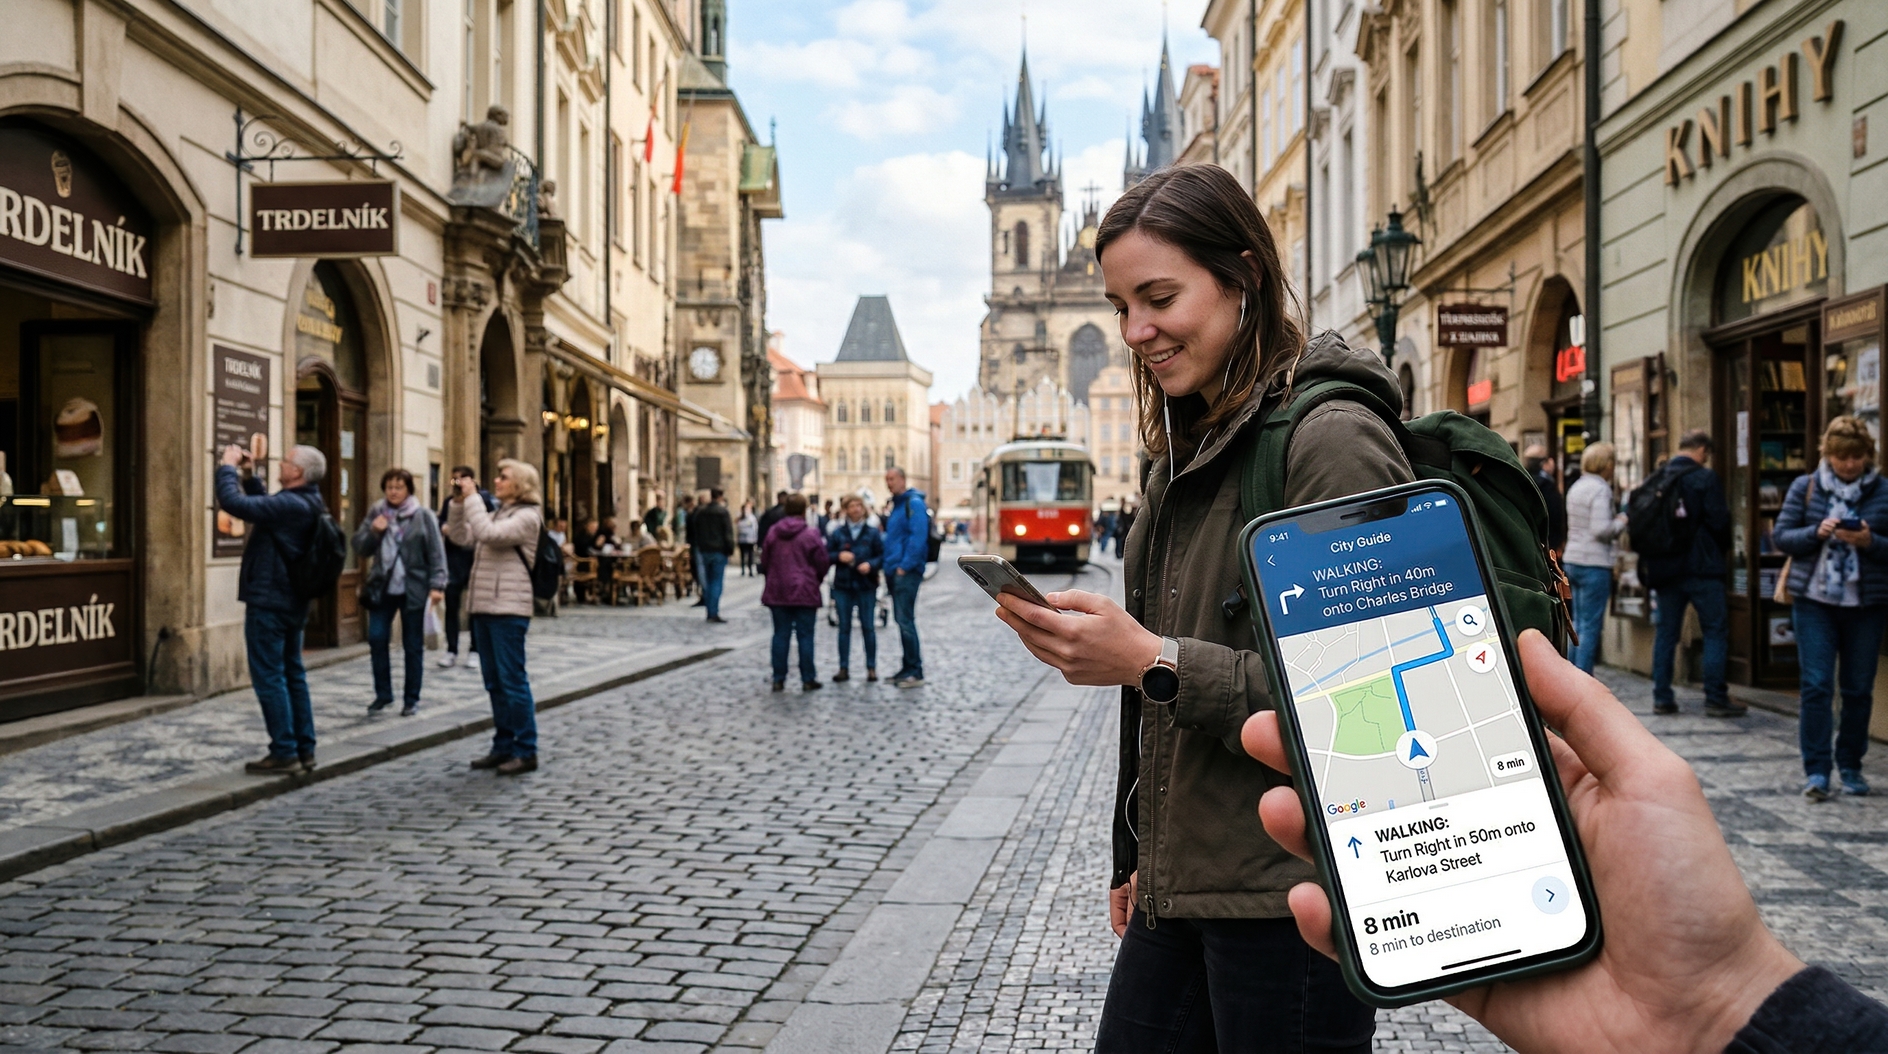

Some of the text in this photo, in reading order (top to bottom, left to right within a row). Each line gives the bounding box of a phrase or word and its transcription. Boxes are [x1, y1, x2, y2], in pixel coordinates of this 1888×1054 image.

[1664, 18, 1846, 188] KNIHY
[0, 185, 148, 279] RDELNÍK
[257, 201, 389, 231] TRDELNÍK
[1742, 229, 1828, 304] KNIHY
[1269, 531, 1290, 544] 9:41
[1330, 532, 1392, 553] City Guide
[1312, 558, 1383, 582] WALKING:
[1317, 567, 1436, 599] Turn Right in 40m
[1322, 581, 1454, 617] onto Charles Bridge
[0, 593, 116, 651] RDELNÍK
[1496, 758, 1525, 770] 8 min
[1327, 798, 1367, 816] Google
[1374, 816, 1450, 843] WALKING:
[1380, 821, 1536, 863] Turn Right in 50m onto
[1385, 852, 1483, 884] Karlova Street
[1363, 909, 1420, 935] 8 min
[1369, 918, 1502, 955] 8 min to destination
